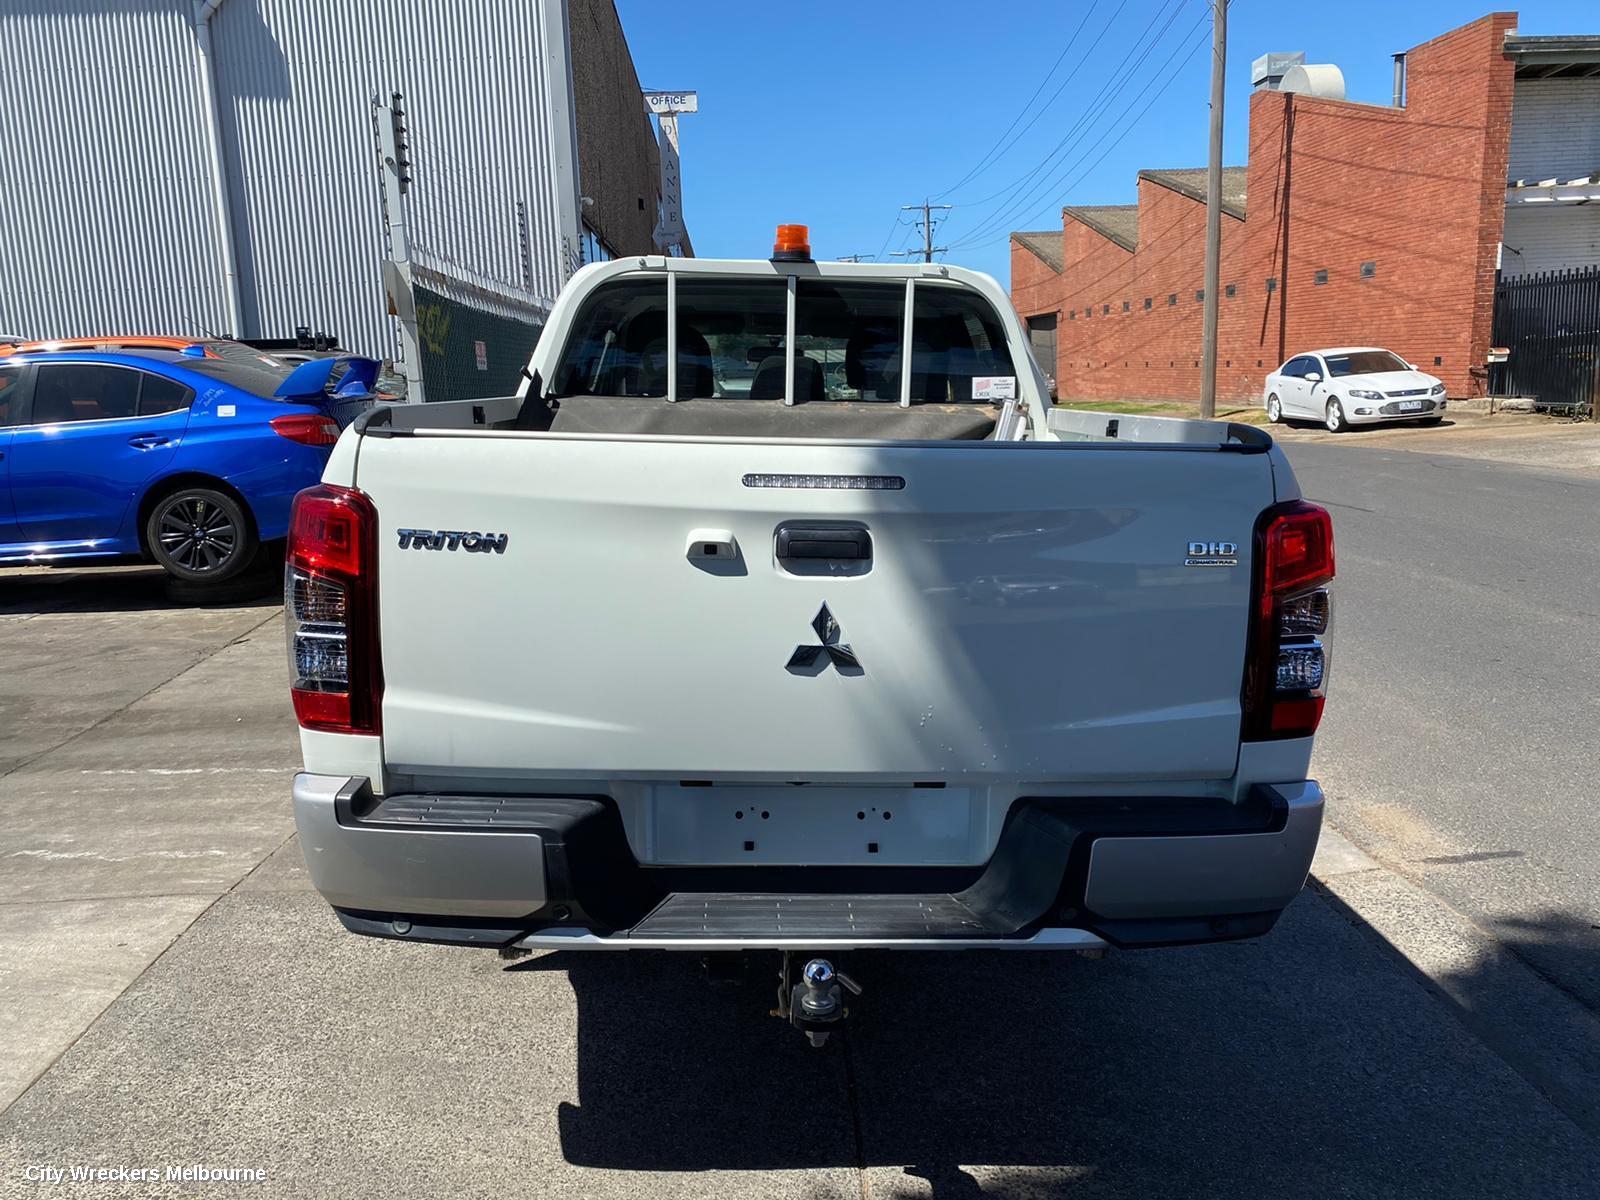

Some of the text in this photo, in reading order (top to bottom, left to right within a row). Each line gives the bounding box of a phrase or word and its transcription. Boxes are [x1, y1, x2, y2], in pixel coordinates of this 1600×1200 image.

[651, 96, 687, 105] OFFICE
[664, 125, 677, 222] DIANNE
[397, 528, 508, 554] TRITON
